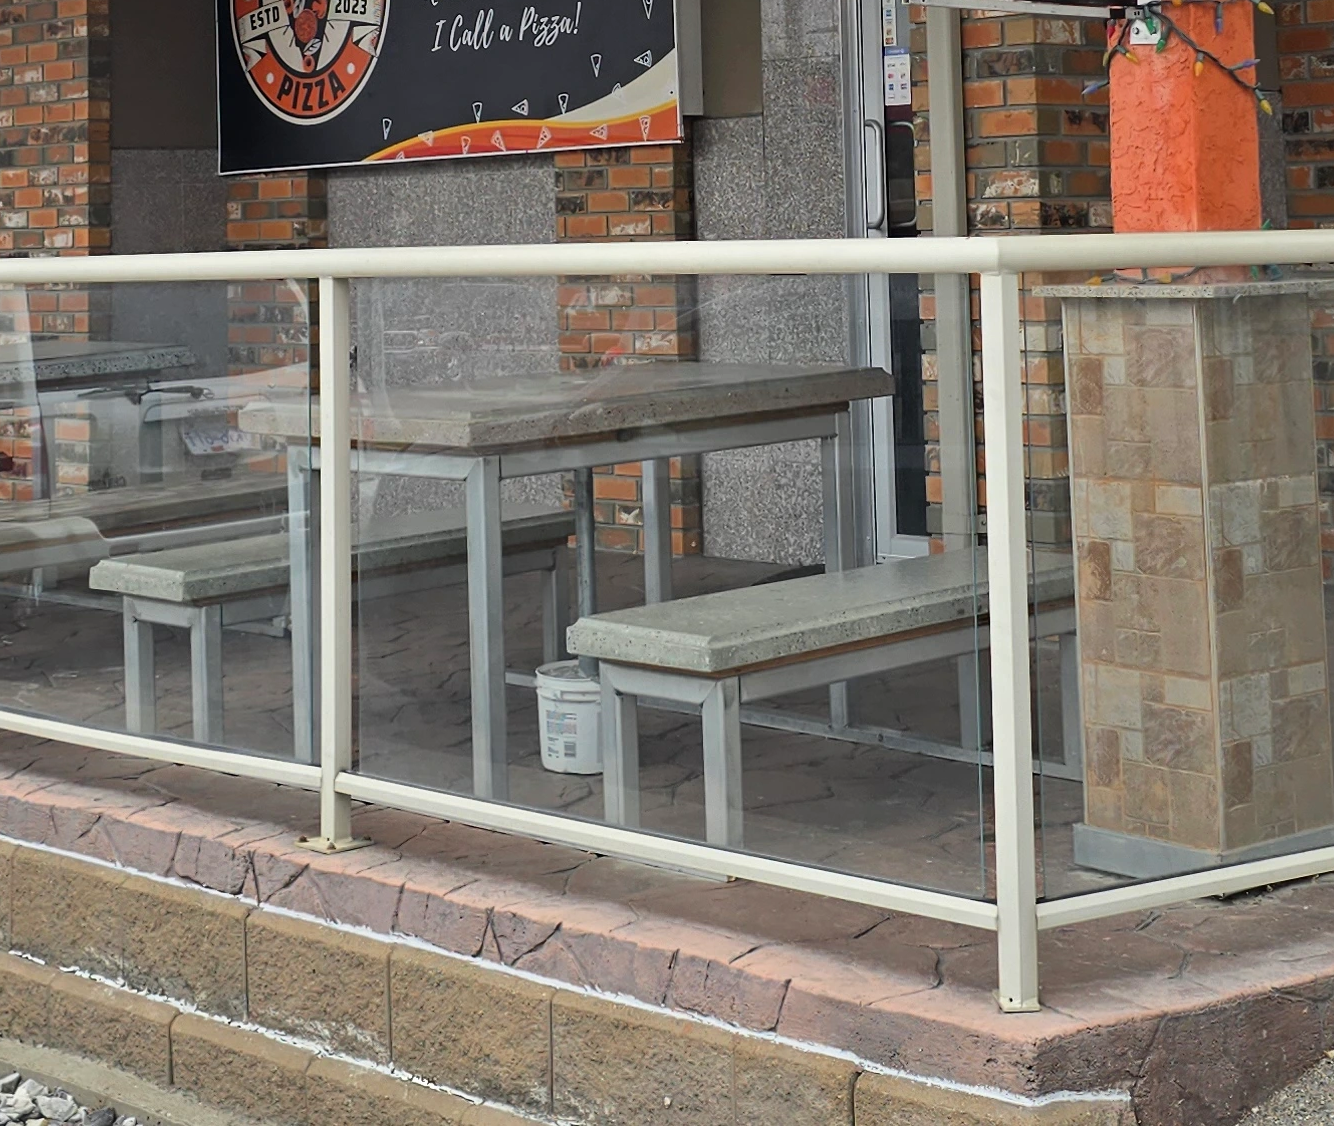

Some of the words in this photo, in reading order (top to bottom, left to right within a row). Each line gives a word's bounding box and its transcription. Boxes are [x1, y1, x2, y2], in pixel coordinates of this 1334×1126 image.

[249, 4, 280, 31] ESTD
[431, 19, 447, 52] I
[449, 8, 495, 52] Call
[499, 24, 514, 42] a
[518, 1, 582, 47] Pizza!
[277, 73, 347, 112] PIZZA
